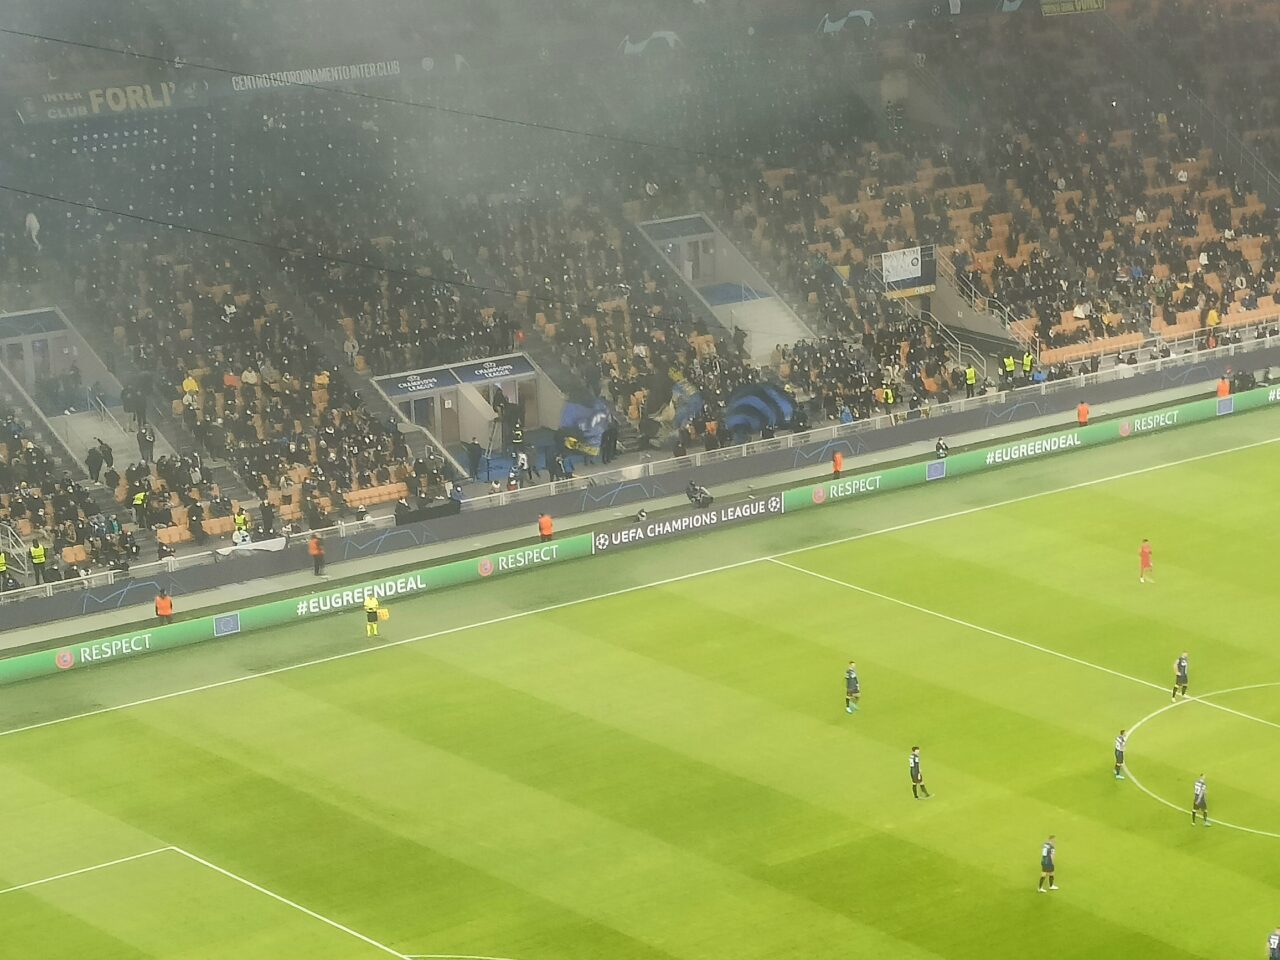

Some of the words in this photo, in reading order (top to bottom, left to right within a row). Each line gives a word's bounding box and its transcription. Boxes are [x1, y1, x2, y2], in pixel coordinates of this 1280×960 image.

[231, 73, 270, 91] CENTRO
[270, 65, 350, 88] COORDINAMENTO
[350, 62, 376, 80] INTER
[376, 60, 400, 76] CLUB
[43, 91, 82, 103] INTER
[47, 105, 88, 119] CLUB
[474, 364, 513, 376] CHAMPIONS
[484, 369, 511, 379] LEAGUE
[398, 376, 437, 389] CHAMPIONS
[408, 383, 435, 392] LEAGUE
[1134, 410, 1180, 432] RESPECT
[985, 433, 1081, 465] #EUGREENDEAL
[829, 475, 882, 498] RESPECT
[611, 526, 645, 546] UEFA
[646, 511, 718, 538] CHAMPIONS
[720, 500, 766, 523] LEAGUE
[498, 544, 559, 571] RESPECT
[296, 574, 427, 617] #EUGREENDEAL
[80, 634, 152, 664] RESPECT
